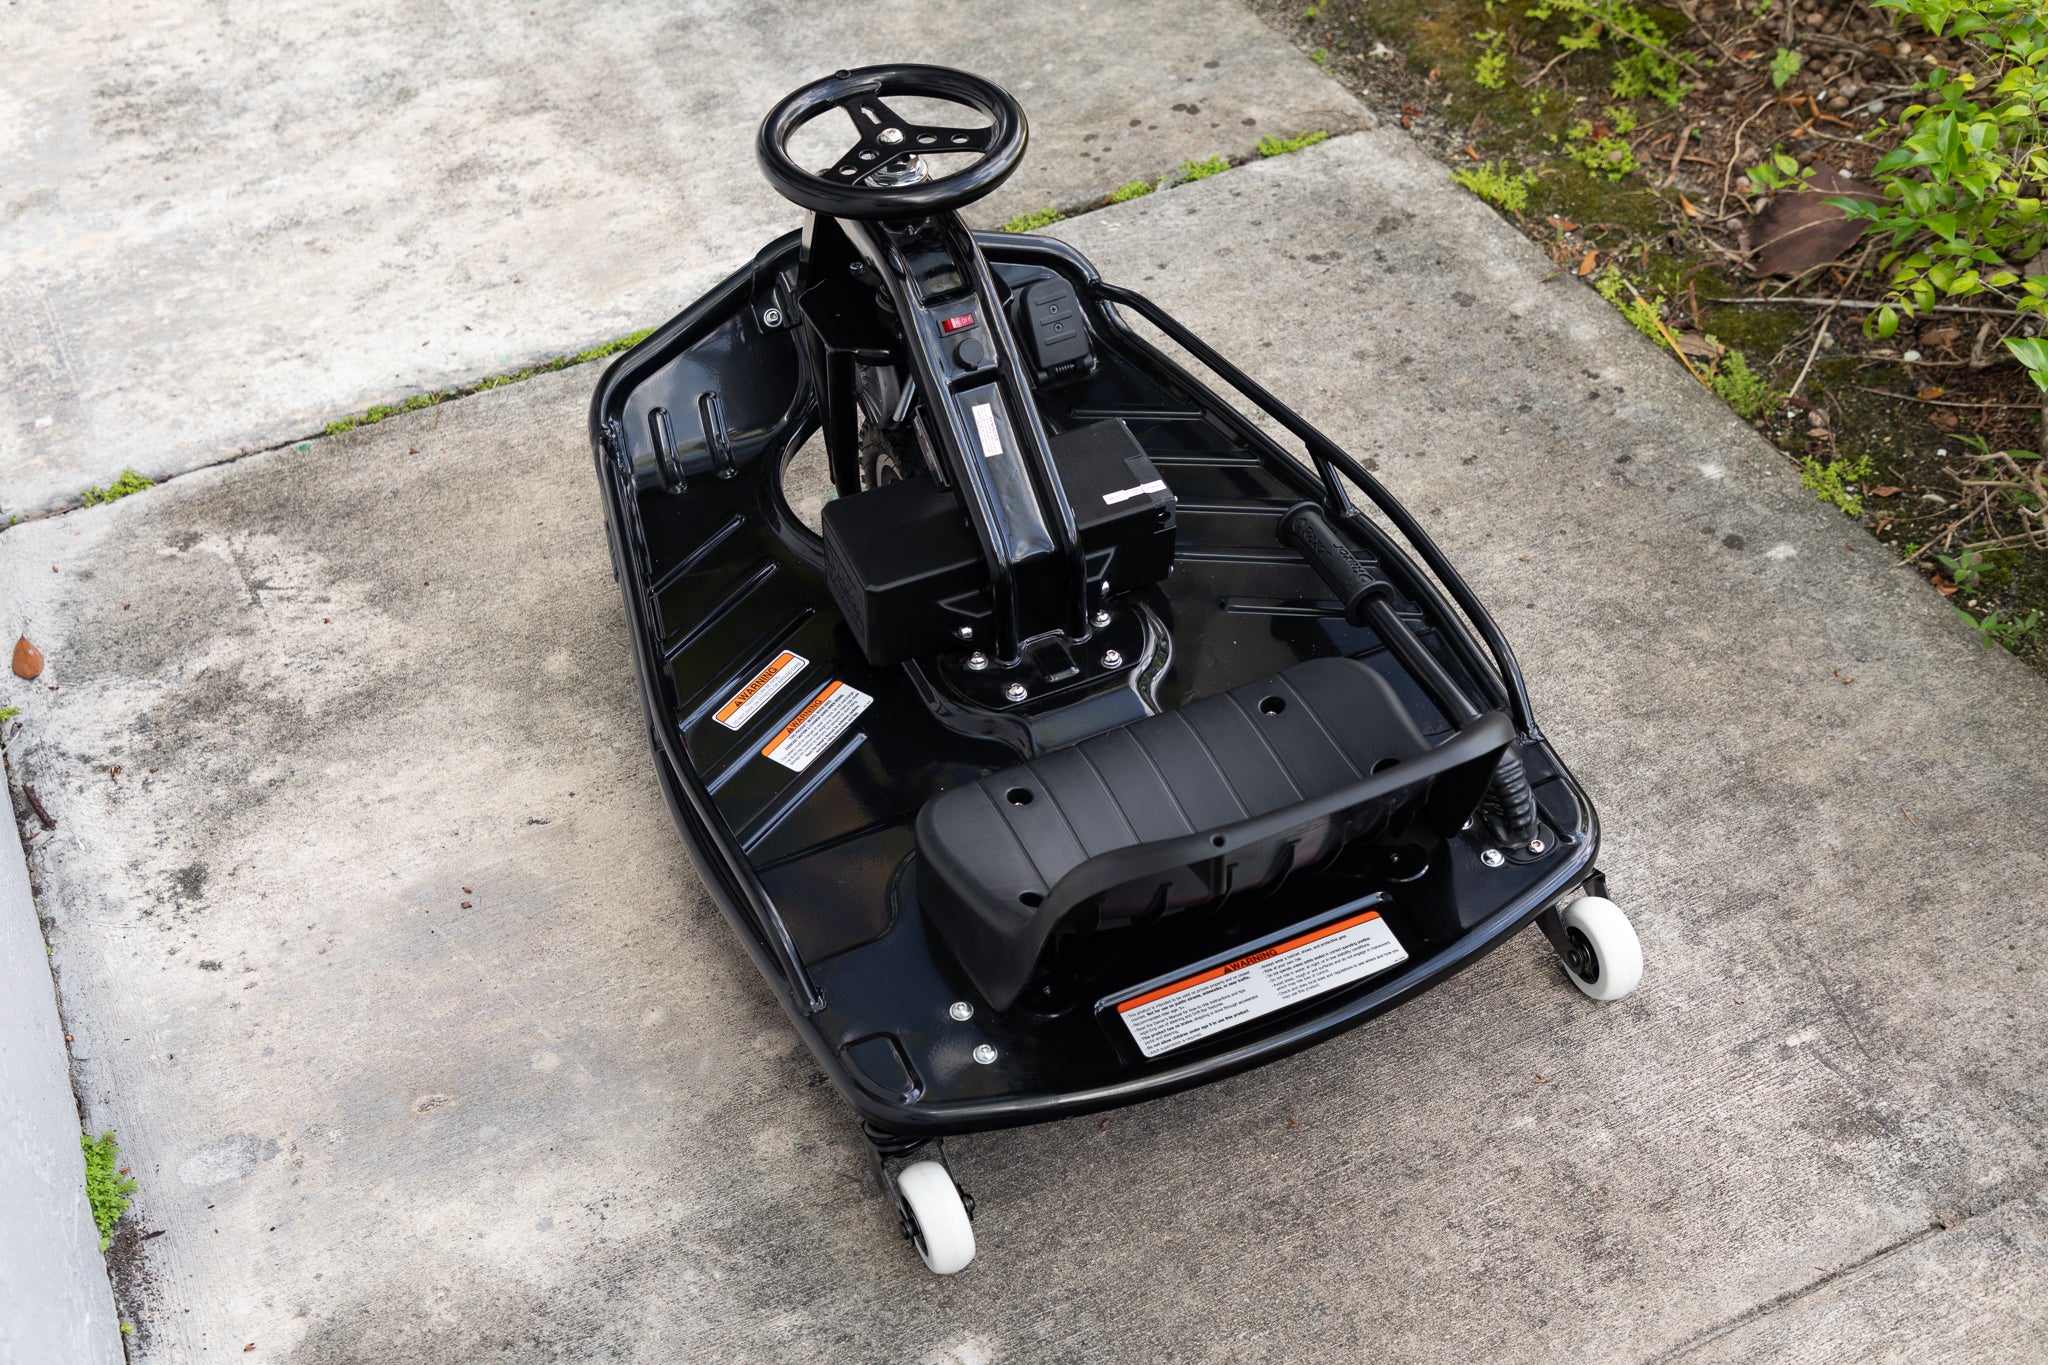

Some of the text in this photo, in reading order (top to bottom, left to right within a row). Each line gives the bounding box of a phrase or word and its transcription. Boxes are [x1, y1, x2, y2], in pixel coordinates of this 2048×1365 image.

[738, 666, 778, 701] WARNING
[791, 699, 822, 729] WARNING
[1230, 949, 1278, 971] WARNING
